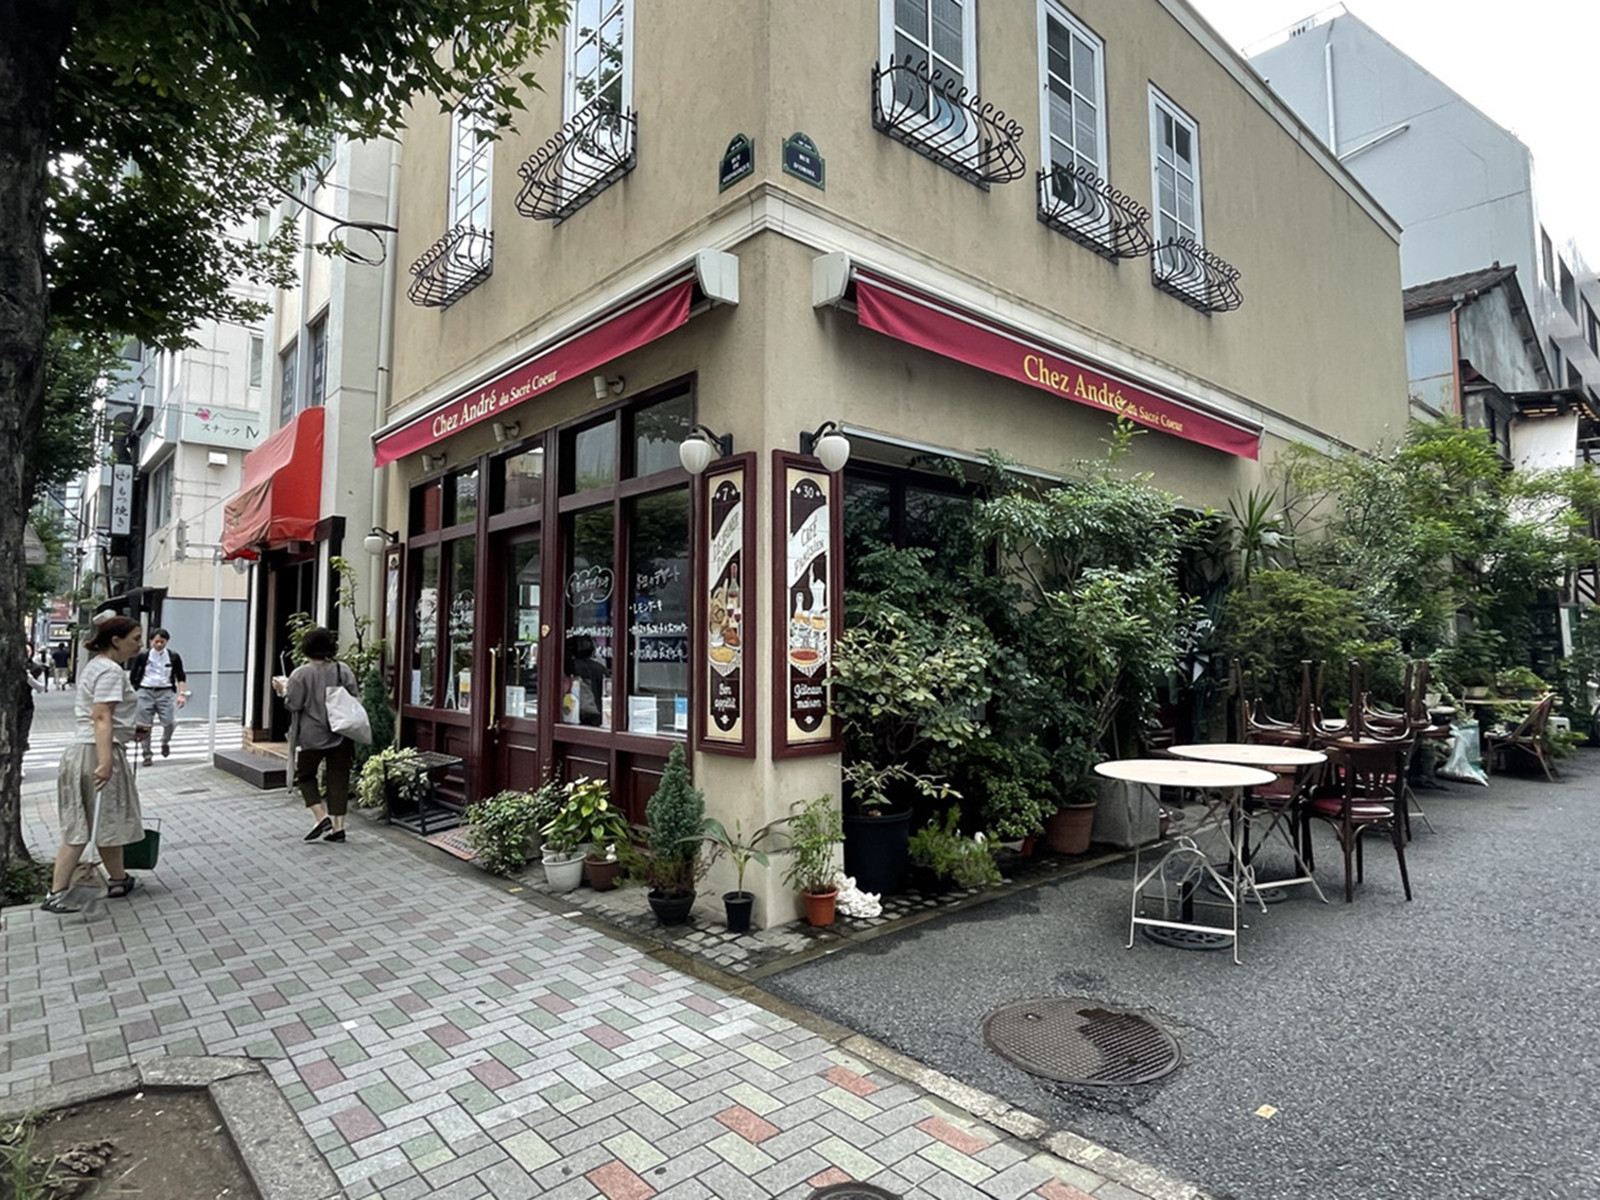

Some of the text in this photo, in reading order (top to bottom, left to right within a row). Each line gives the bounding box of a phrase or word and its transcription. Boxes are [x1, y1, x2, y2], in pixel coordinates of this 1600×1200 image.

[1023, 354, 1070, 393] Chez
[1074, 374, 1125, 411] André
[1139, 405, 1160, 424] Sacré
[432, 414, 459, 438] Chez
[460, 389, 497, 426] André
[510, 379, 531, 402] Sacré
[201, 423, 241, 437] スナック
[722, 488, 729, 501] 7
[803, 485, 815, 499] 30
[114, 486, 129, 528] もつ焼き
[796, 697, 822, 708] maison
